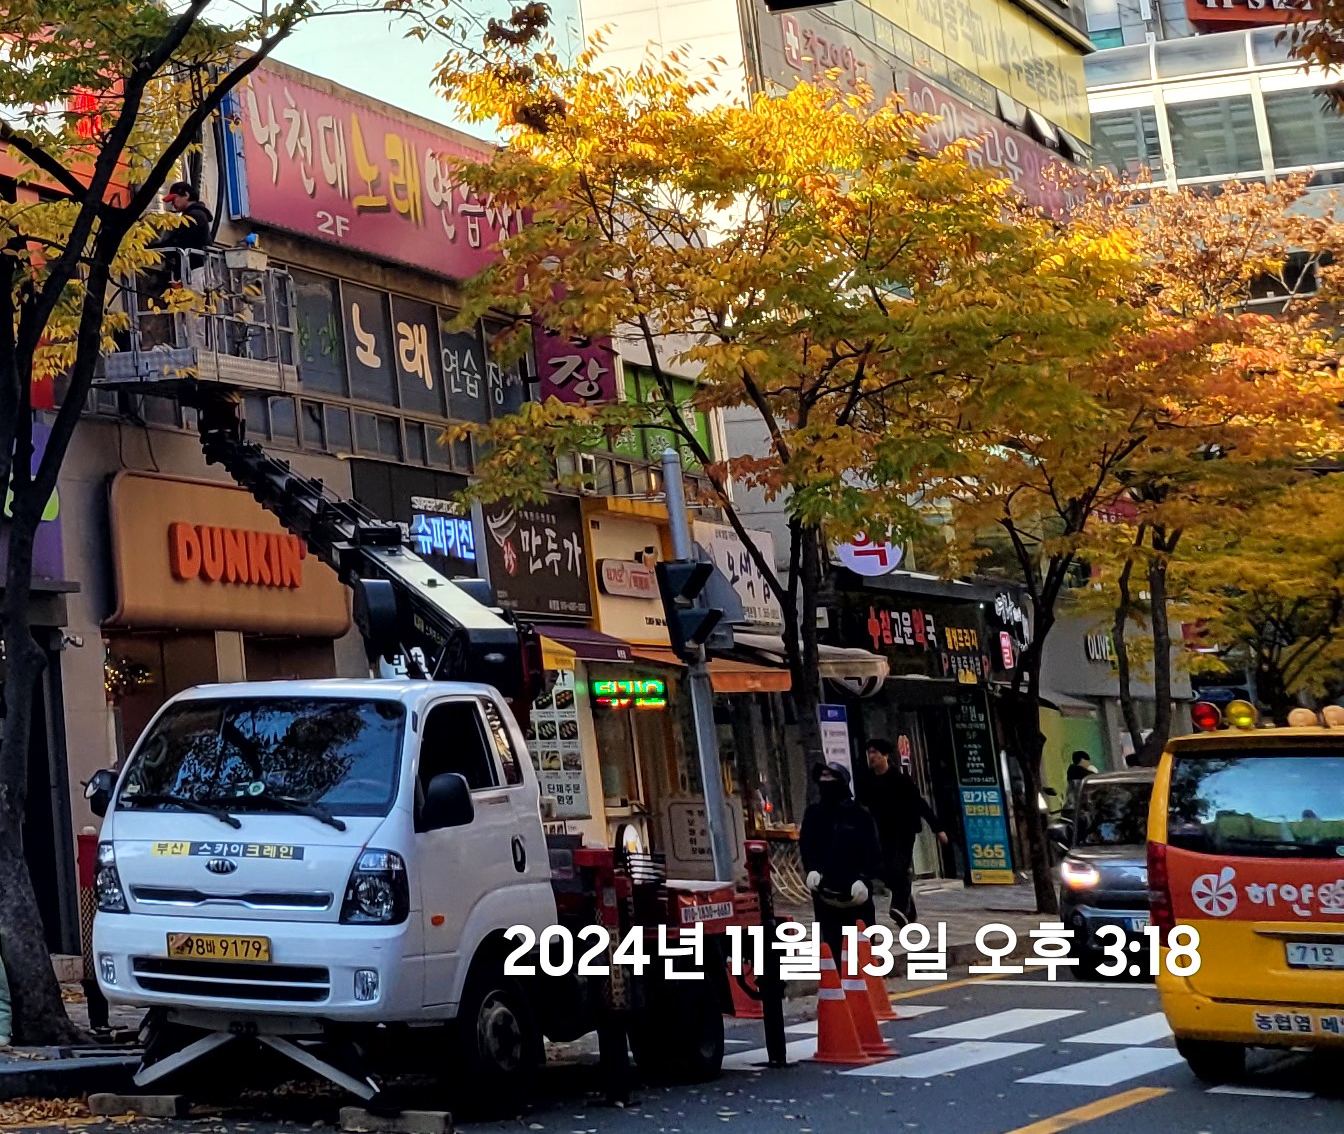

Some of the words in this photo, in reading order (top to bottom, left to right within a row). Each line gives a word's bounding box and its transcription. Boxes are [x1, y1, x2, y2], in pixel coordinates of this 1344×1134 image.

[316, 210, 351, 238] 2F
[417, 514, 476, 561] 슈퍼키친
[168, 521, 305, 589] DUNKIN
[519, 525, 583, 579] 만두가
[155, 841, 187, 857] 부산
[197, 842, 297, 860] 스카이크레인
[971, 842, 1006, 859] 365
[210, 861, 232, 872] KIA
[219, 938, 263, 960] 9179
